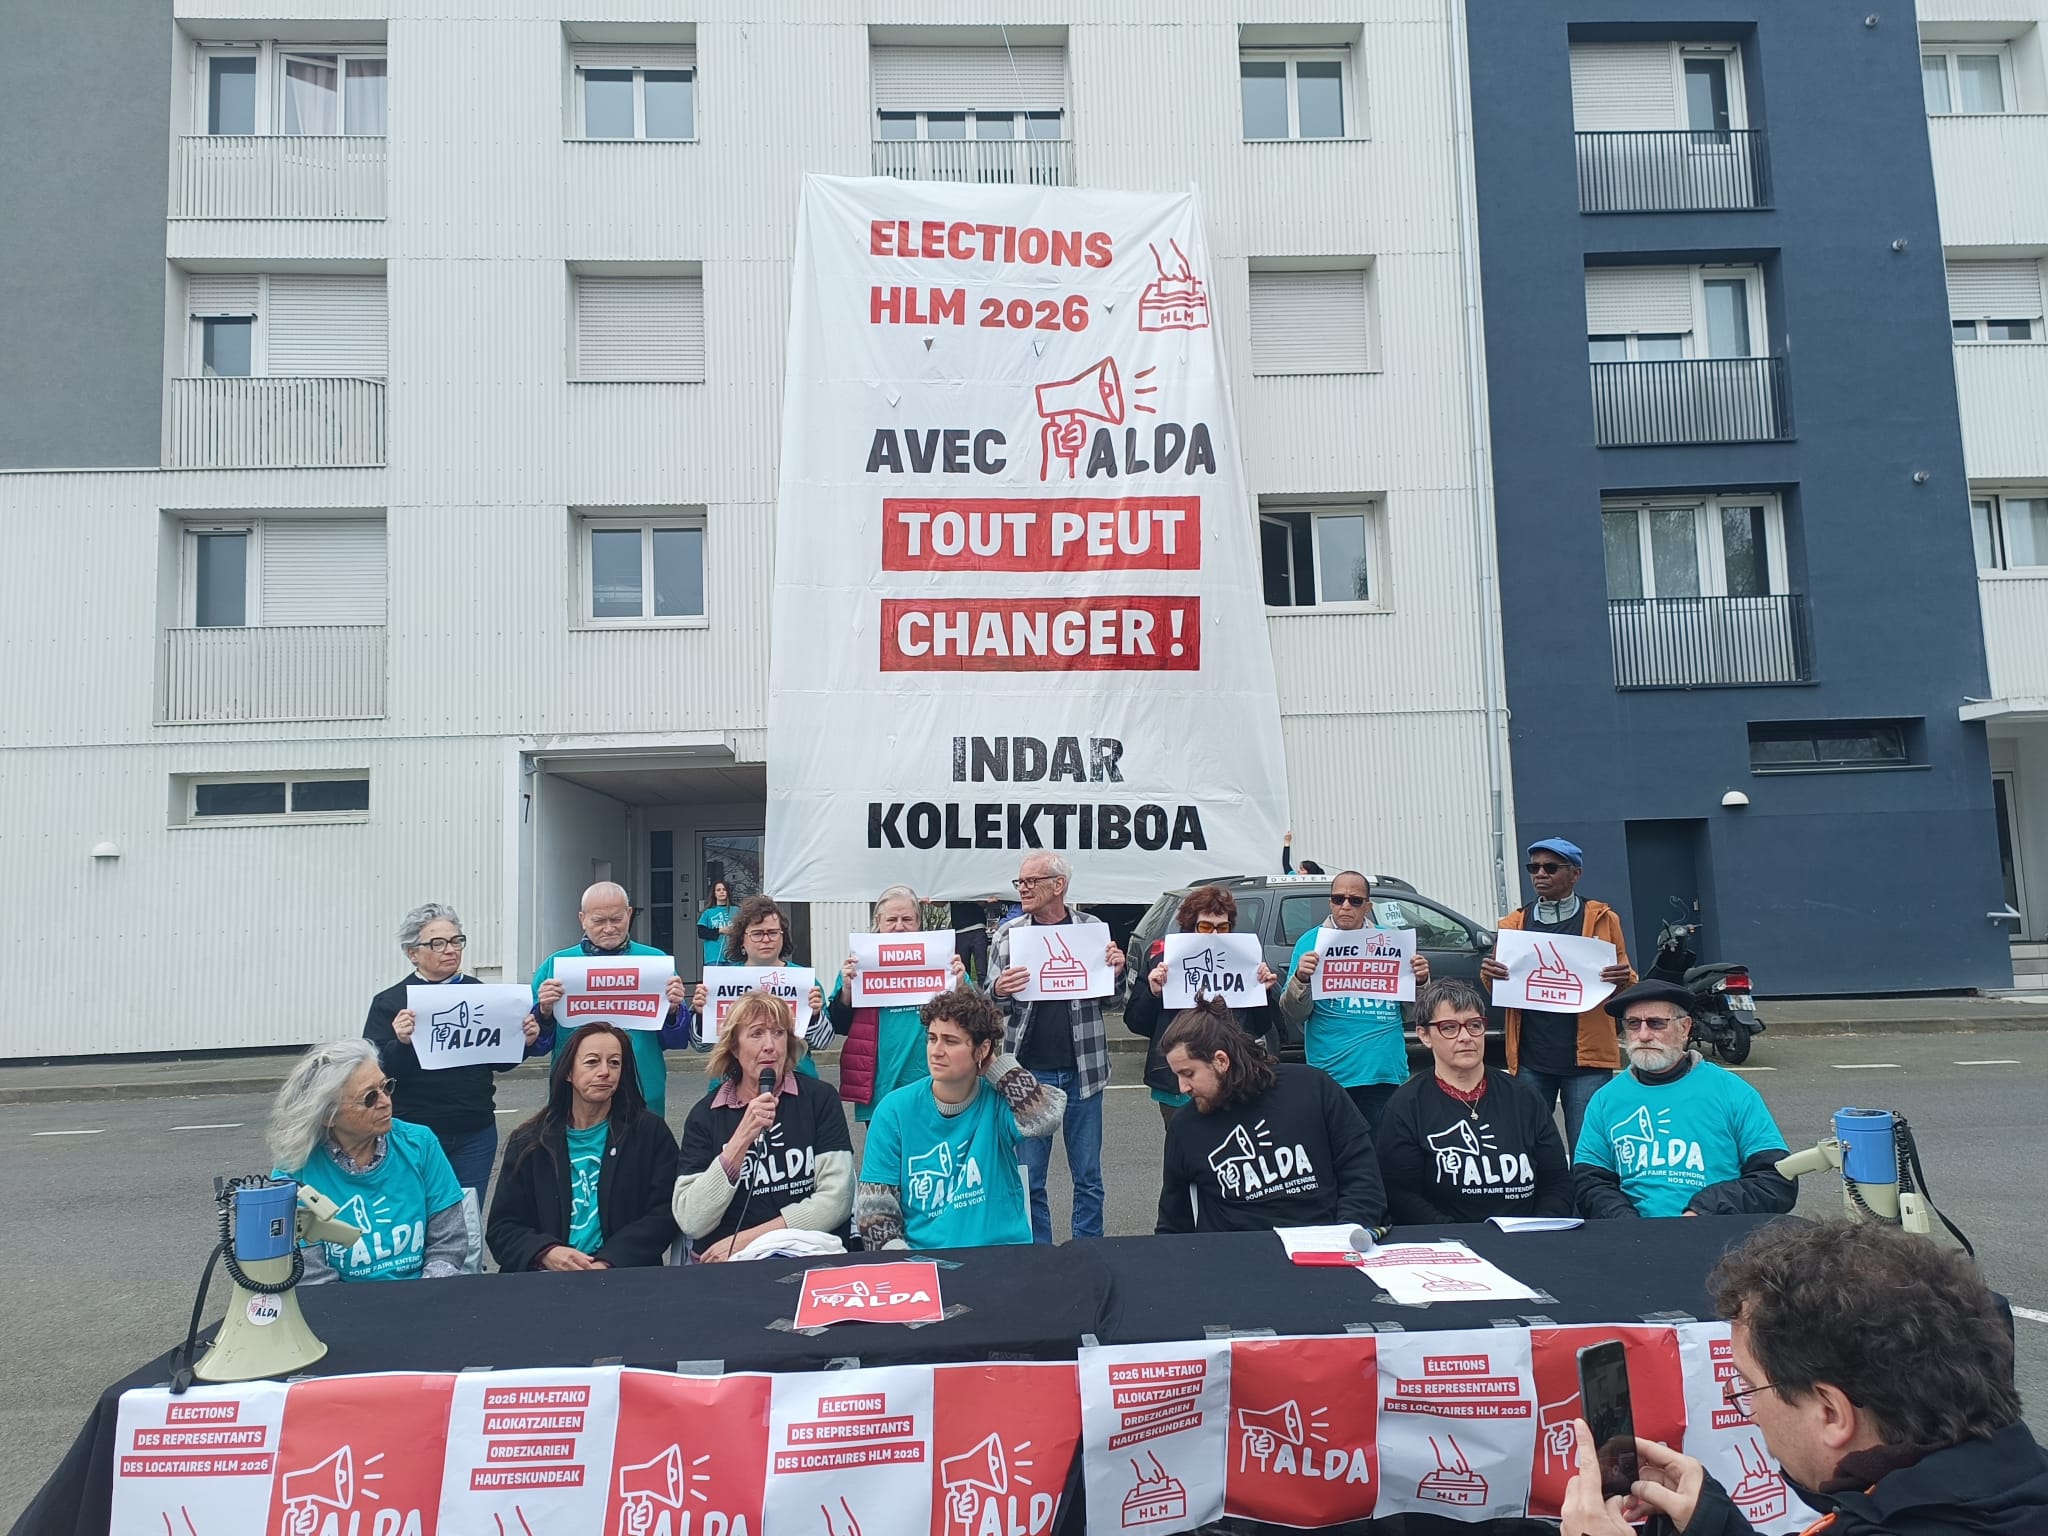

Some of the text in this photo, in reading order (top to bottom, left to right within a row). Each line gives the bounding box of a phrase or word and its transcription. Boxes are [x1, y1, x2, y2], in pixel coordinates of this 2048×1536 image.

[870, 220, 1112, 268] ELECTIONS
[870, 287, 1088, 331] HLM 2026
[1161, 310, 1194, 323] HLM
[866, 424, 1217, 478] AVEC ALDA
[899, 510, 1185, 556] TOUT PEUT
[898, 609, 1155, 656] CHANGER
[952, 736, 1124, 783] INDAR
[868, 802, 1207, 851] KOLEKTIBOA
[882, 950, 921, 961] INDAR
[1326, 946, 1402, 958] AVEC ALDA
[1327, 962, 1396, 973] TOUT PEUT
[590, 975, 635, 987] INDAR
[866, 977, 943, 990] KOLEKTIBOA
[1053, 979, 1075, 987] HLM
[1201, 973, 1245, 992] ALDA
[1325, 979, 1387, 990] CHANGER
[771, 986, 797, 997] ALDA
[1541, 990, 1567, 1000] HLM
[570, 1000, 656, 1012] KOLEKTIBOA
[447, 1028, 501, 1049] ALDA
[1635, 1139, 1705, 1172] ALDA
[754, 1146, 815, 1187] ALDA
[1242, 1144, 1313, 1193] ALDA
[1463, 1153, 1534, 1186] ALDA
[1669, 1170, 1705, 1180] ENTENDRE
[753, 1187, 770, 1196] POUR
[1245, 1175, 1317, 1201] POUR FAIRE ENTENDRE
[1286, 1185, 1301, 1195] NOS
[954, 1200, 968, 1210] NOS
[351, 1221, 425, 1268] ALDA
[349, 1268, 371, 1277] POUR
[844, 1291, 931, 1308] ALDA
[255, 1307, 278, 1319] ALDA
[1713, 1347, 1732, 1356] 202
[1112, 1364, 1203, 1380] 2026 HLM-ETAKO
[1428, 1359, 1486, 1372] ÉLECTIONS
[1117, 1384, 1201, 1404] ALOKATZAILEEN
[1400, 1382, 1516, 1394] DES REPRESENTANTS
[488, 1391, 586, 1405] 2026 HLM-ETAKO
[171, 1406, 235, 1420] ÉLECTIONS
[822, 1399, 882, 1414] ÉLECTIONS
[1387, 1402, 1527, 1416] DES LOCATAIRES HLM 2026
[1124, 1403, 1190, 1427] ORDEZKARIEN
[488, 1416, 581, 1430] ALOKATZAILEEN
[792, 1421, 910, 1440] DES REPRESENTANTS
[138, 1431, 262, 1446] DES REPRESENTANTS
[1112, 1416, 1198, 1447] HAUTESKUNDEAK
[490, 1445, 569, 1458] ORDEZKARIEN
[777, 1448, 920, 1469] DES LOCATAIRES HLM 2026
[123, 1459, 268, 1473] DES LOCATAIRES HLM 2026
[1273, 1444, 1370, 1484] ALDA
[475, 1470, 580, 1486] HAUTESKUNDEAK
[1437, 1491, 1468, 1502] HLM
[979, 1492, 1062, 1536] ALD
[1139, 1504, 1168, 1519] HLM
[1750, 1502, 1773, 1518] HLM
